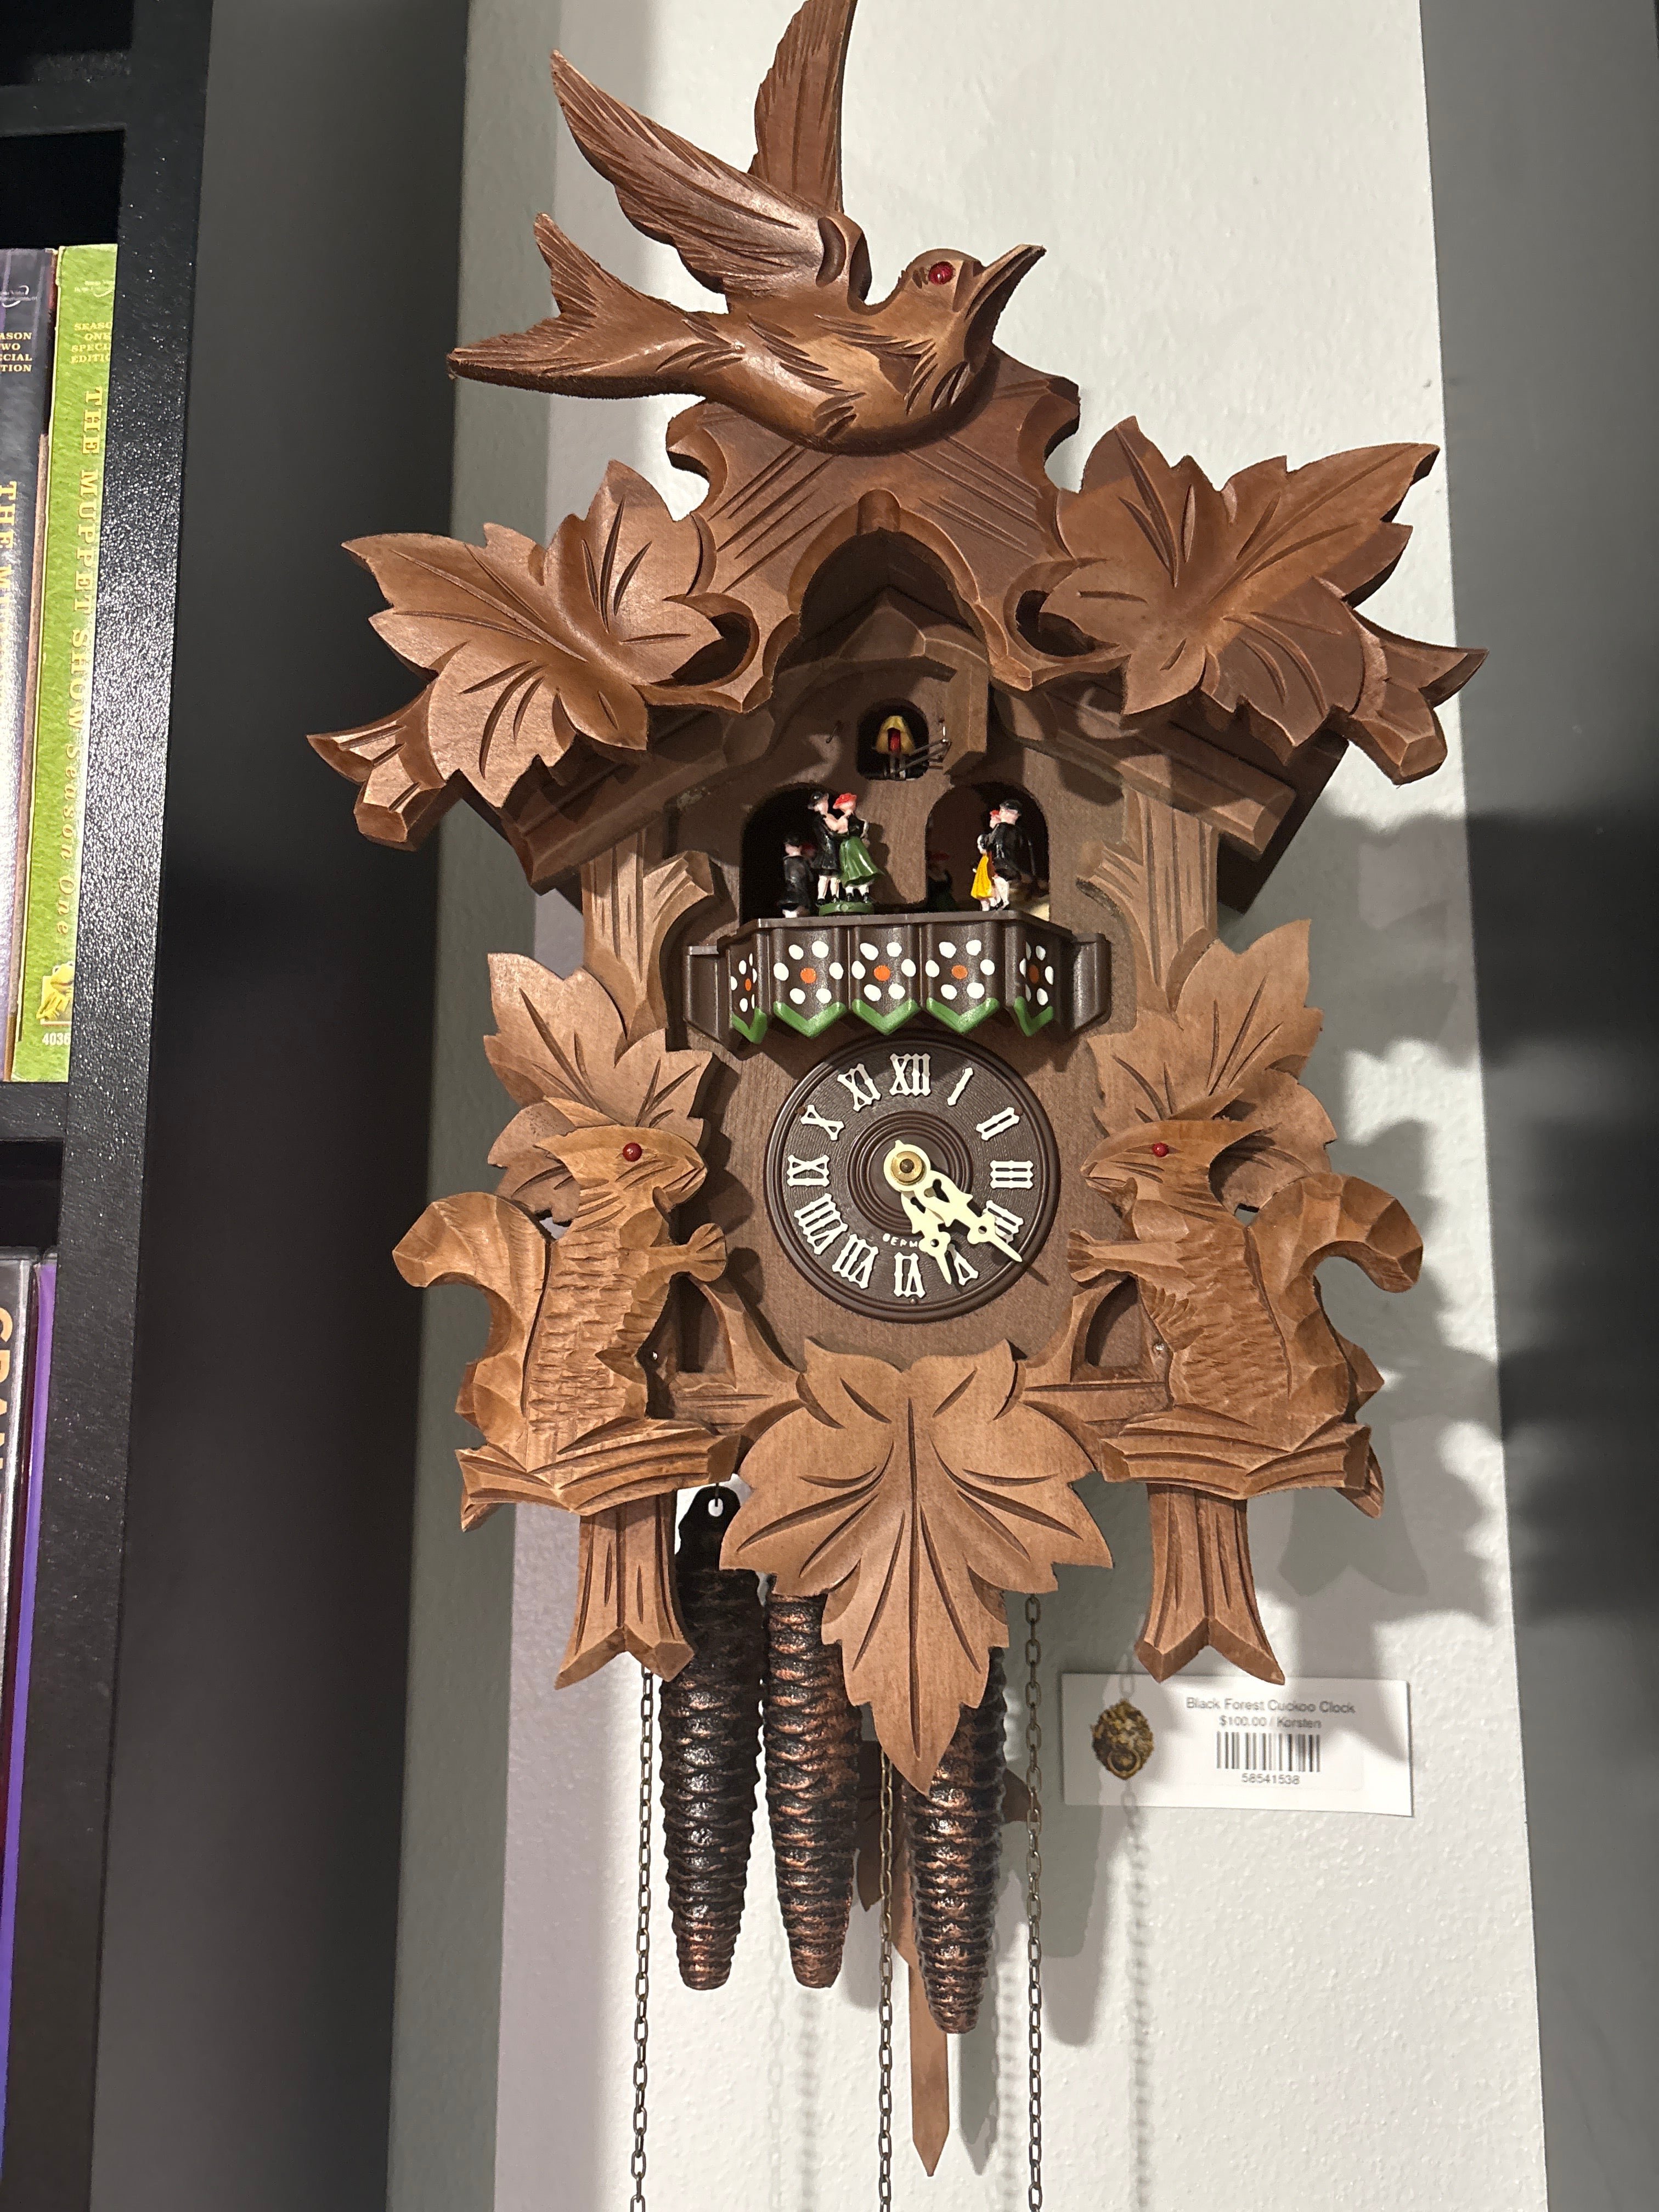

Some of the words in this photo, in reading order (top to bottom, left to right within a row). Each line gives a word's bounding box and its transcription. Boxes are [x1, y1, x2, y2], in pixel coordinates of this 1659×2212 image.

[0, 332, 32, 340] ASON
[74, 322, 112, 331] SEASO
[84, 332, 111, 341] ONE
[0, 342, 20, 351] WO
[71, 343, 111, 353] SPECI
[71, 353, 110, 364] EDITIO
[0, 364, 32, 372] TION
[82, 386, 103, 455] THE
[74, 469, 99, 614] MUPPET
[68, 629, 89, 730] SHOW
[60, 743, 81, 860] Season
[57, 875, 75, 935] One
[837, 1063, 882, 1112] XI
[889, 1052, 932, 1097] XII
[800, 1104, 845, 1141] X
[975, 1107, 1020, 1141] II
[786, 1154, 830, 1187] IX
[990, 1159, 1034, 1189] III
[793, 1193, 849, 1256] VIII
[832, 1233, 879, 1290] VII
[893, 1251, 926, 1299] VI
[1186, 1697, 1221, 1709] Black
[1224, 1698, 1265, 1711] Forest
[1268, 1699, 1316, 1712] Cuckoo
[1319, 1701, 1356, 1713] Clock
[1219, 1715, 1267, 1726] $100.00
[1242, 1773, 1300, 1785] 58541538
